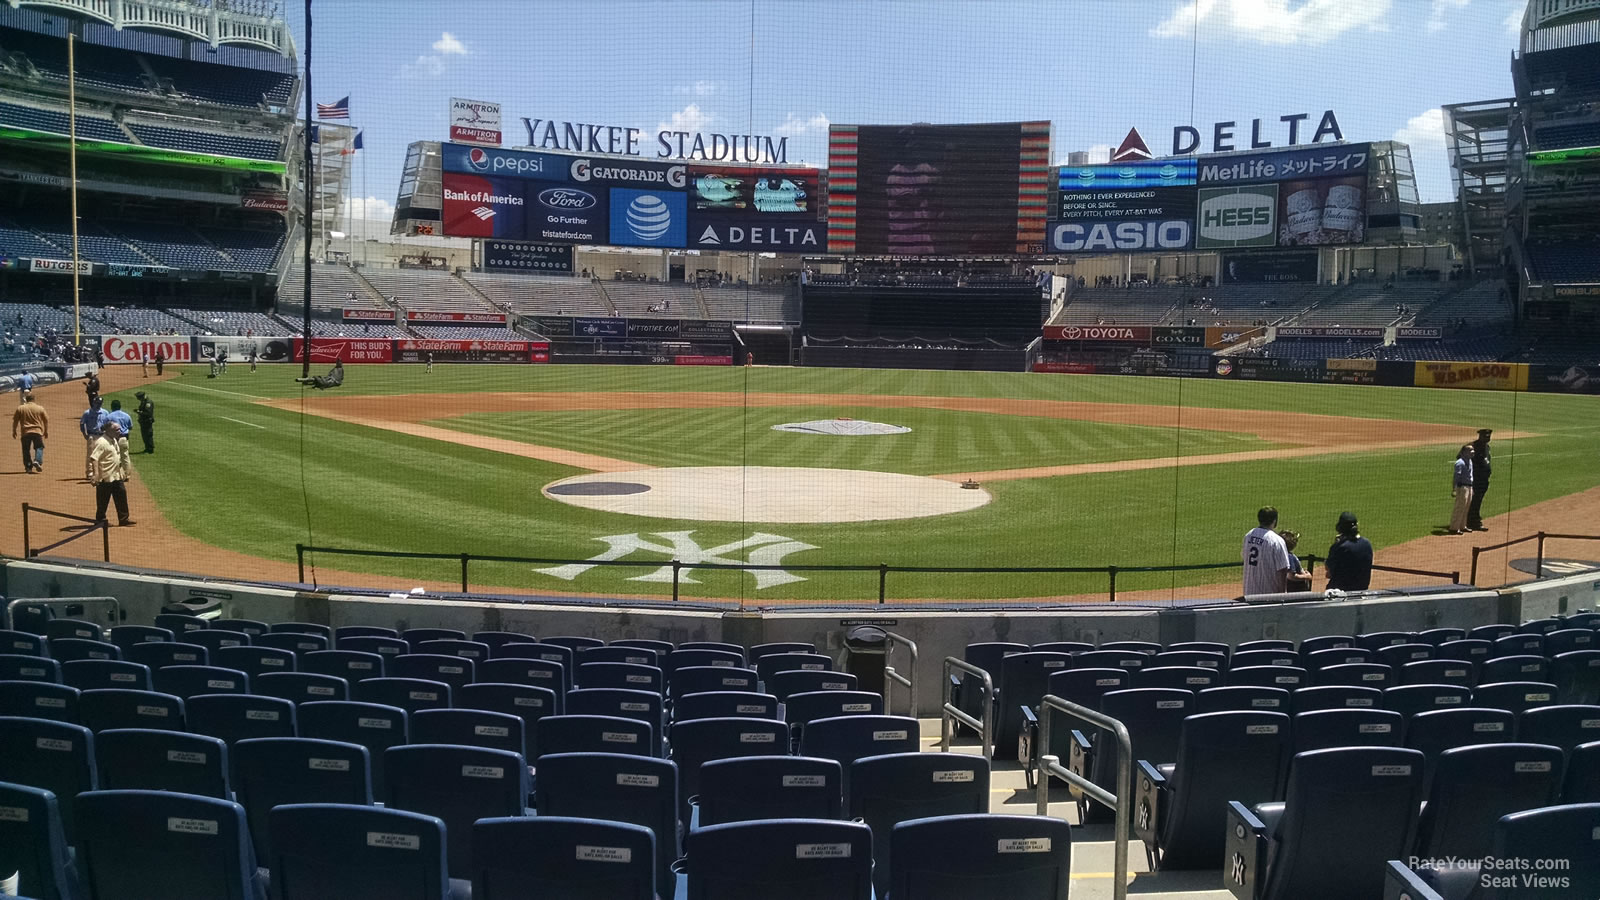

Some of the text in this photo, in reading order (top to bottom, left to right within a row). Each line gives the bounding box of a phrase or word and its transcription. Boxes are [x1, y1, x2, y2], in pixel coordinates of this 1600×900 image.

[454, 102, 500, 113] ARMITRON
[456, 128, 498, 138] ARMITRON
[520, 117, 789, 164] YANKEE STADIUM
[1173, 110, 1344, 155] DELTA
[494, 156, 543, 174] pepsi
[1201, 160, 1276, 181] MetLife
[1281, 152, 1367, 175] メットライフ
[593, 168, 665, 183] GATORADE
[444, 189, 524, 206] Bank of America
[550, 189, 585, 208] Ford
[1114, 191, 1156, 199] EXPERIENCED
[243, 199, 287, 210] Budweiser
[547, 215, 588, 225] Go Further
[1205, 207, 1270, 228] HESS
[542, 230, 593, 240] tristateford.com
[729, 227, 817, 245] DELTA
[1054, 221, 1190, 250] CASIO
[1083, 328, 1134, 339] TOYOTA
[103, 337, 190, 361] Canon
[350, 342, 391, 350] THIS BUD'S
[350, 351, 384, 359] FOR YOU.
[1248, 546, 1259, 567] 2
